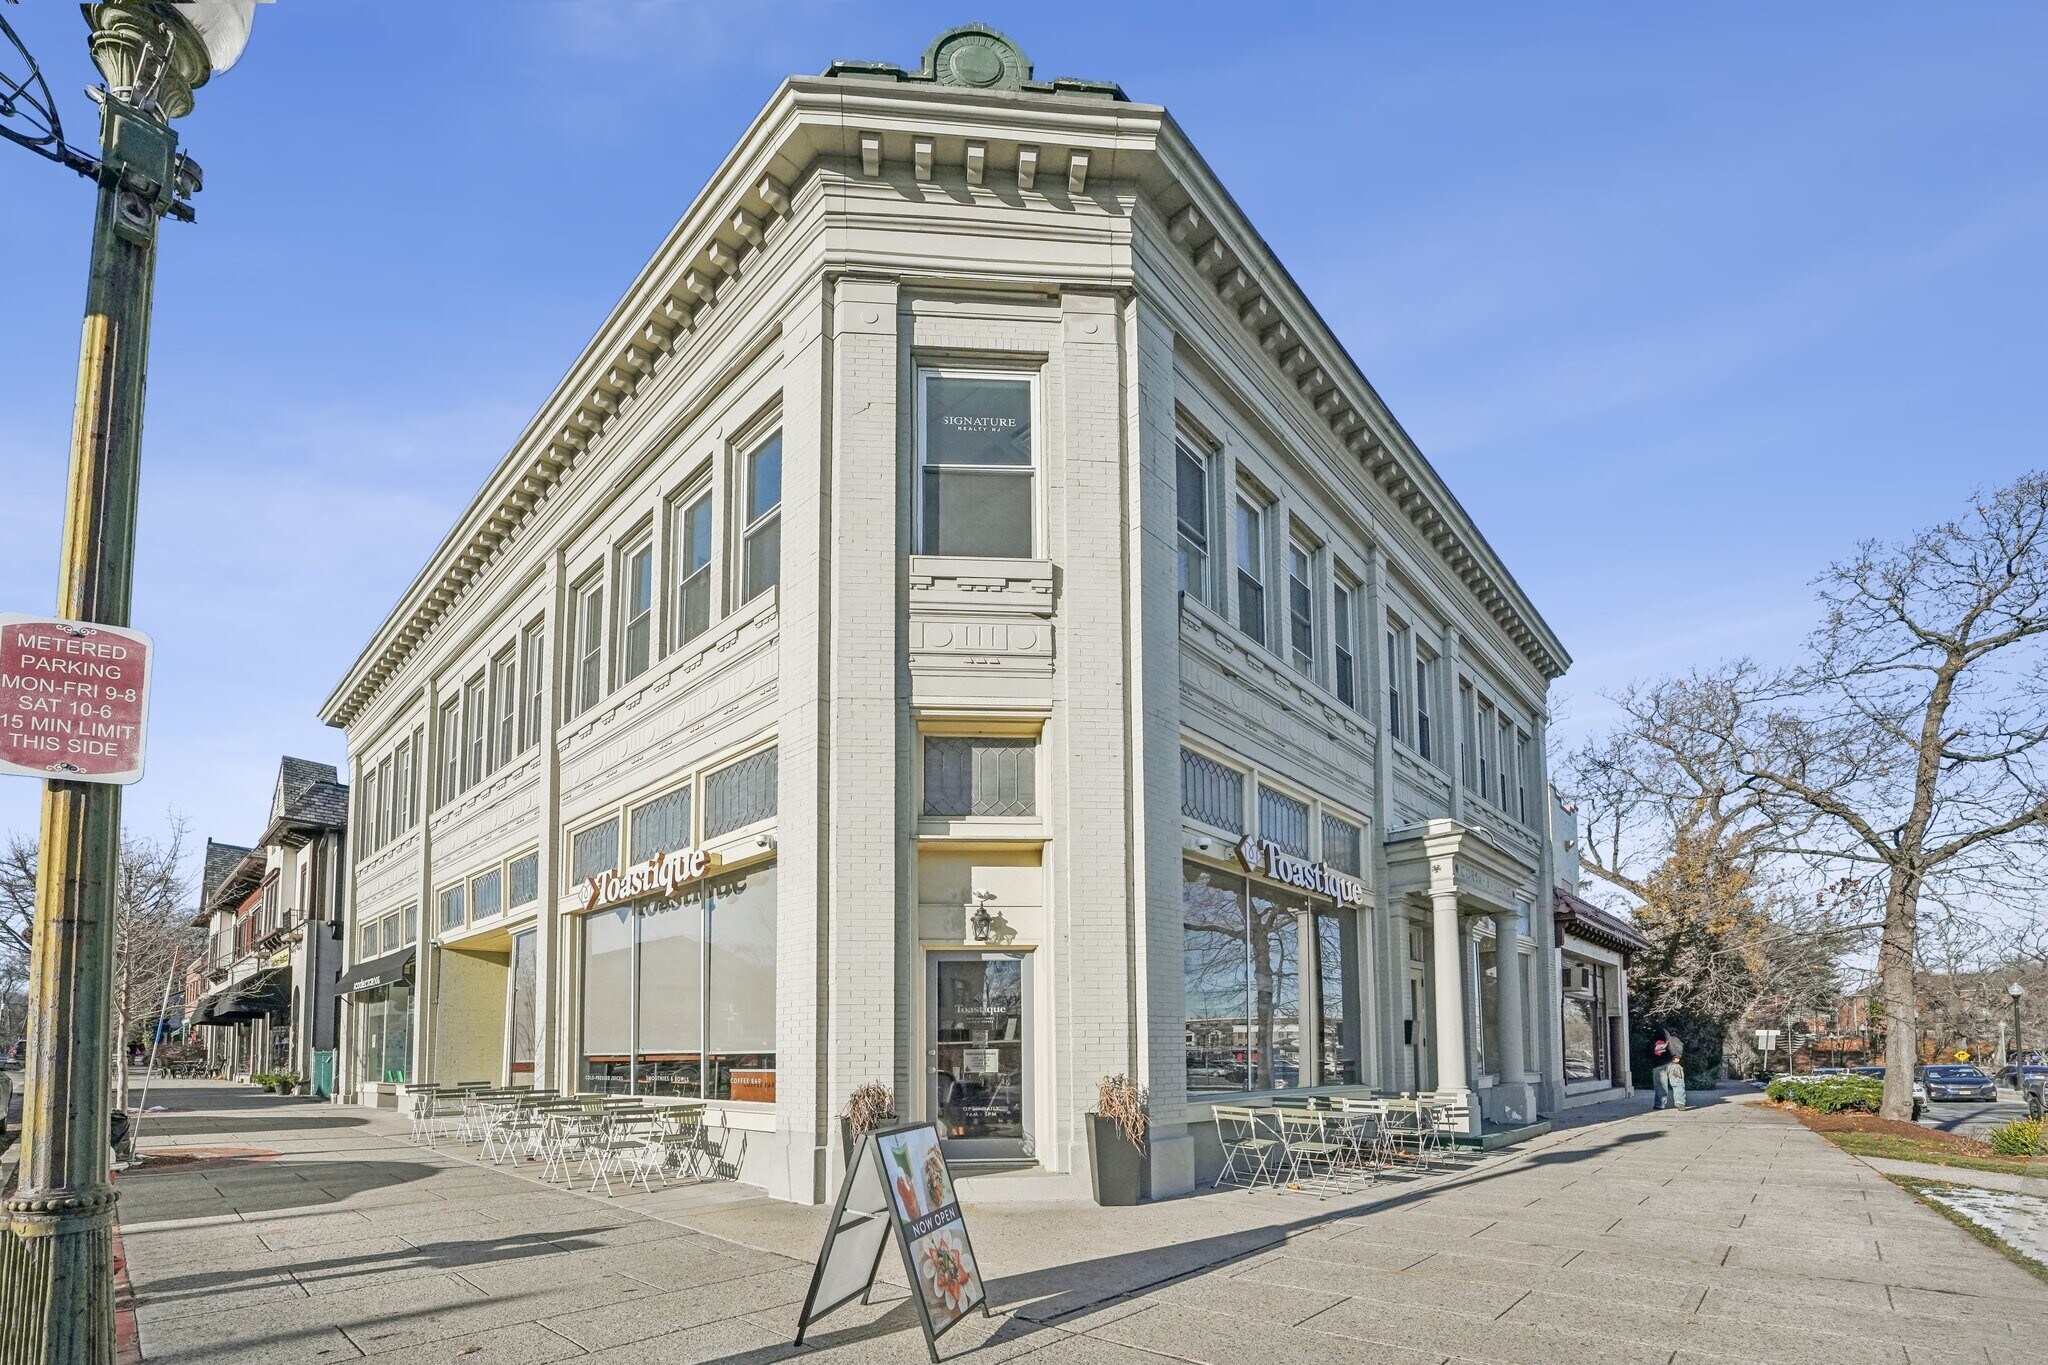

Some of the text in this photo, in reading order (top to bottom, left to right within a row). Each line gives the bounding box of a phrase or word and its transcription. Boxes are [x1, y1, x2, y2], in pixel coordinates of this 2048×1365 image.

[943, 416, 1016, 427] SIGNATURE
[17, 633, 127, 660] METERED
[20, 654, 122, 680] PARKING
[2, 673, 137, 703] MON-FRI 9-8
[18, 695, 112, 719] SAT 10-6
[0, 713, 135, 740] 15 MIN LIMIT
[8, 732, 119, 757] THIS SIDE
[597, 850, 706, 905] Toastique
[1262, 839, 1363, 908] Toastique
[954, 1004, 1007, 1016] Toastique
[912, 1207, 956, 1238] NOW OPEN
